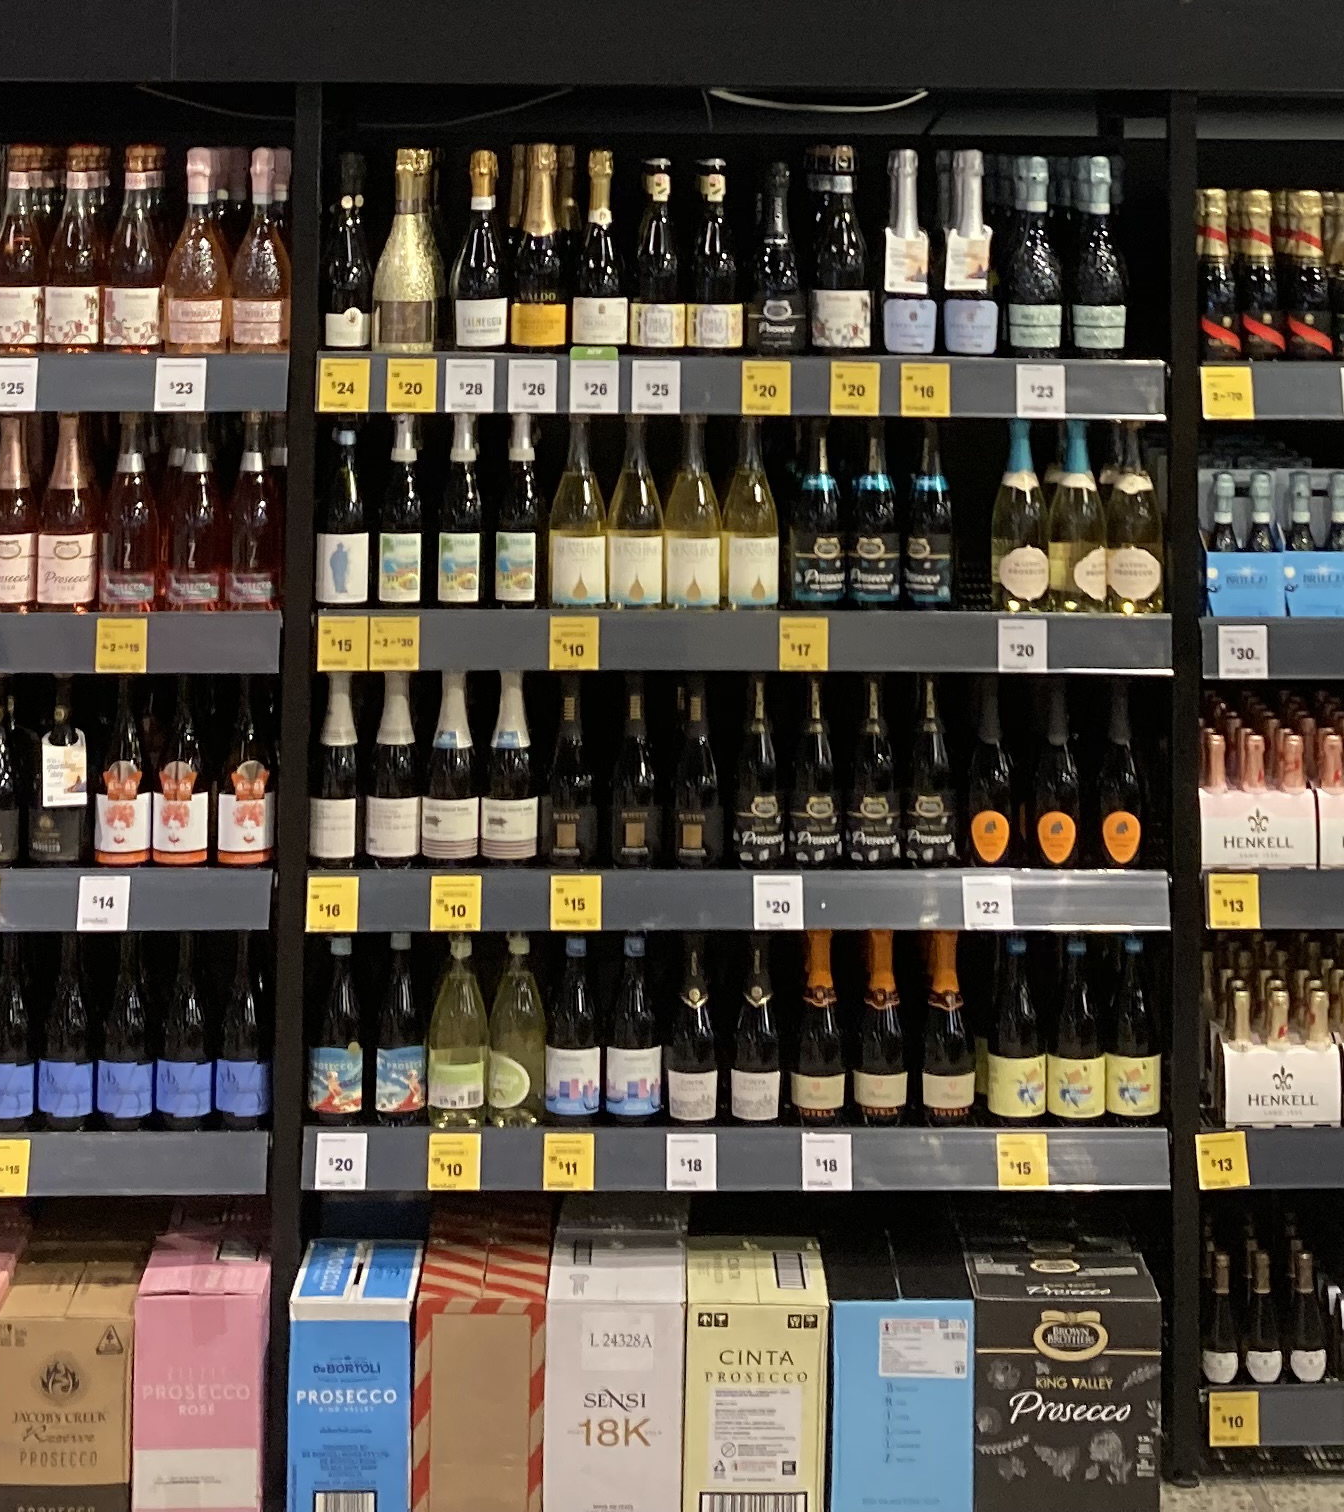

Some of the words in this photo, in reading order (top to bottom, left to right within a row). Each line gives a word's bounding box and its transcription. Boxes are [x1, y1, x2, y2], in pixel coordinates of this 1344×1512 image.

[1, 381, 25, 395] $25
[169, 381, 194, 395] $23
[331, 381, 355, 395] $24
[398, 381, 423, 395] $20
[459, 381, 483, 395] $28
[522, 382, 546, 396] $26
[584, 381, 608, 396] $26
[645, 382, 670, 396] $25
[753, 384, 777, 398] $20
[841, 383, 866, 398] $20
[1030, 384, 1055, 398] $23
[331, 639, 352, 652] $15
[563, 643, 584, 657] $10
[790, 643, 811, 657] $17
[1009, 643, 1035, 658] $20
[1230, 645, 1255, 660] $30
[1223, 835, 1294, 850] HENKELL
[92, 895, 115, 909] $14
[564, 898, 586, 911] $15
[766, 899, 791, 914] $20
[976, 900, 1000, 914] $22
[1222, 898, 1244, 912] $13
[319, 903, 341, 917] $16
[444, 903, 467, 918] $10
[1247, 1093, 1319, 1107] HENKELL
[328, 1157, 354, 1172] $20
[440, 1162, 463, 1177] $10
[559, 1161, 579, 1176] $11
[680, 1158, 702, 1172] $18
[815, 1158, 838, 1172] $18
[1009, 1160, 1032, 1175] $15
[1211, 1157, 1233, 1172] $13
[719, 1348, 795, 1366] CINTA
[704, 1370, 809, 1384] PROSECCO
[1035, 1376, 1068, 1390] KING
[1072, 1376, 1114, 1390] VALLEY
[141, 1384, 251, 1402] PROSECCO
[296, 1389, 397, 1406] PROSECCO
[583, 1388, 646, 1412] SENSI
[1009, 1390, 1132, 1425] Prosecco
[1221, 1414, 1244, 1428] $10
[577, 1416, 652, 1448] 18K
[19, 1450, 99, 1468] PROSECCO
